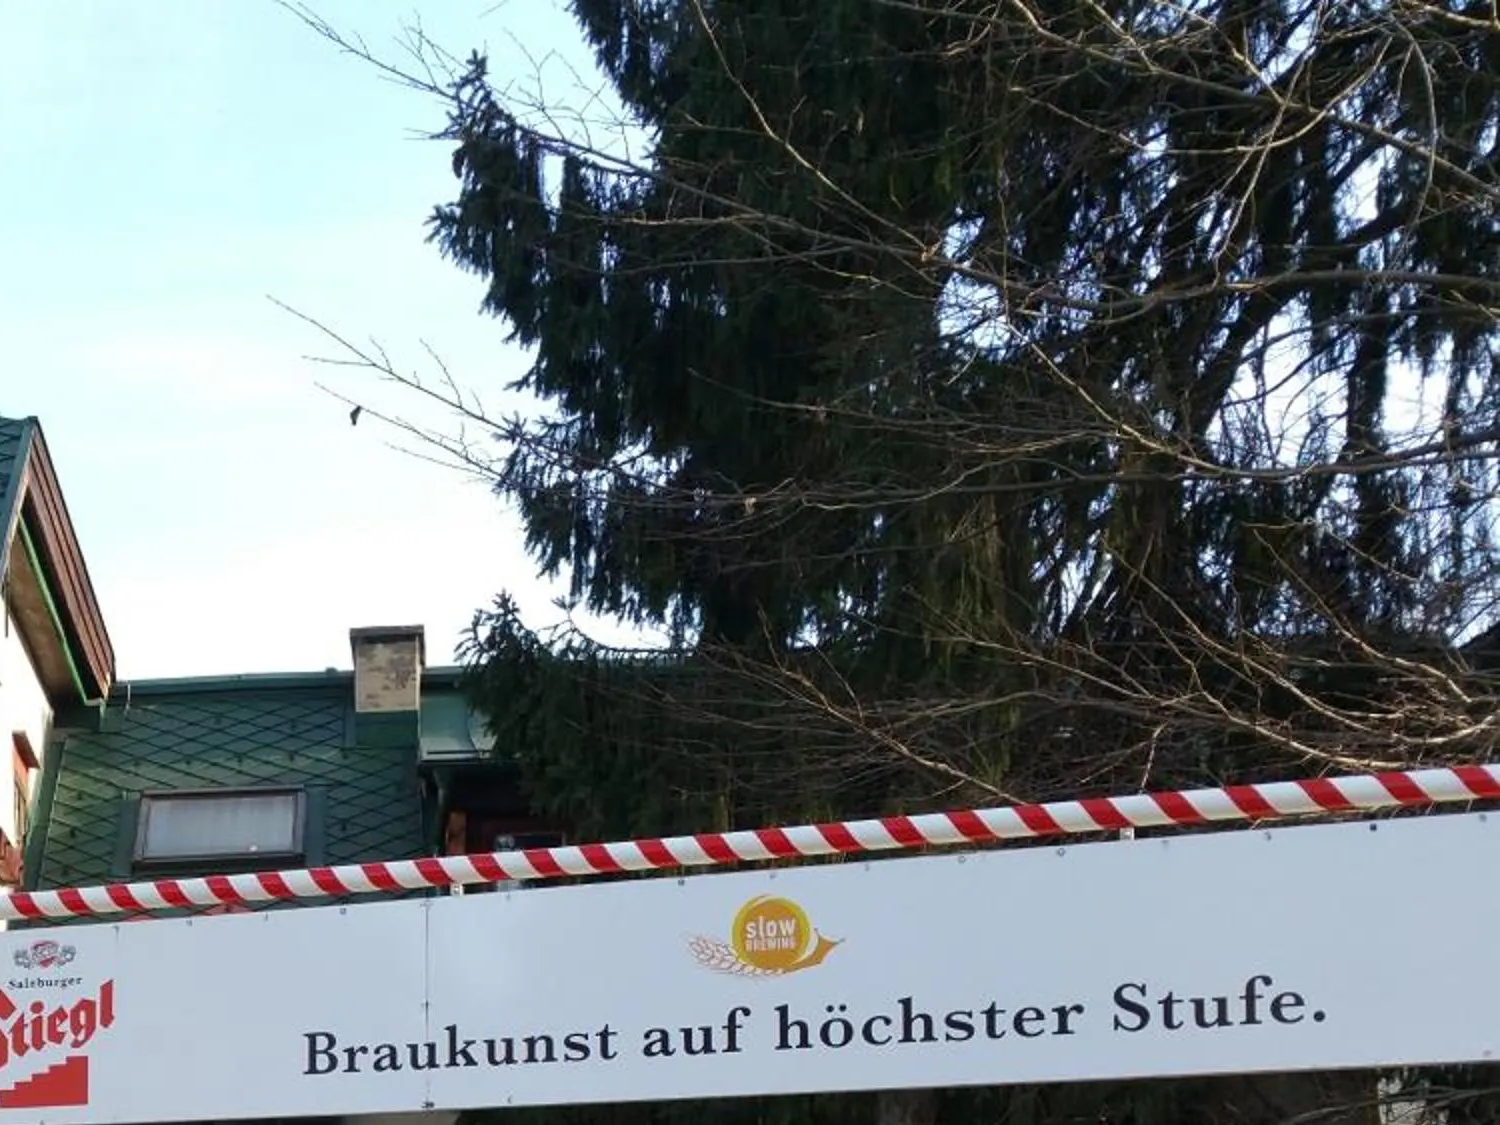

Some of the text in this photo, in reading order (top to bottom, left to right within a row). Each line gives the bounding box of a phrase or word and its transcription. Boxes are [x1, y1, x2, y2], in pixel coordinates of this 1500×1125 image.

[8, 976, 83, 990] Salzburger
[302, 974, 1327, 1075] Braukunst auf höchster Stufe.
